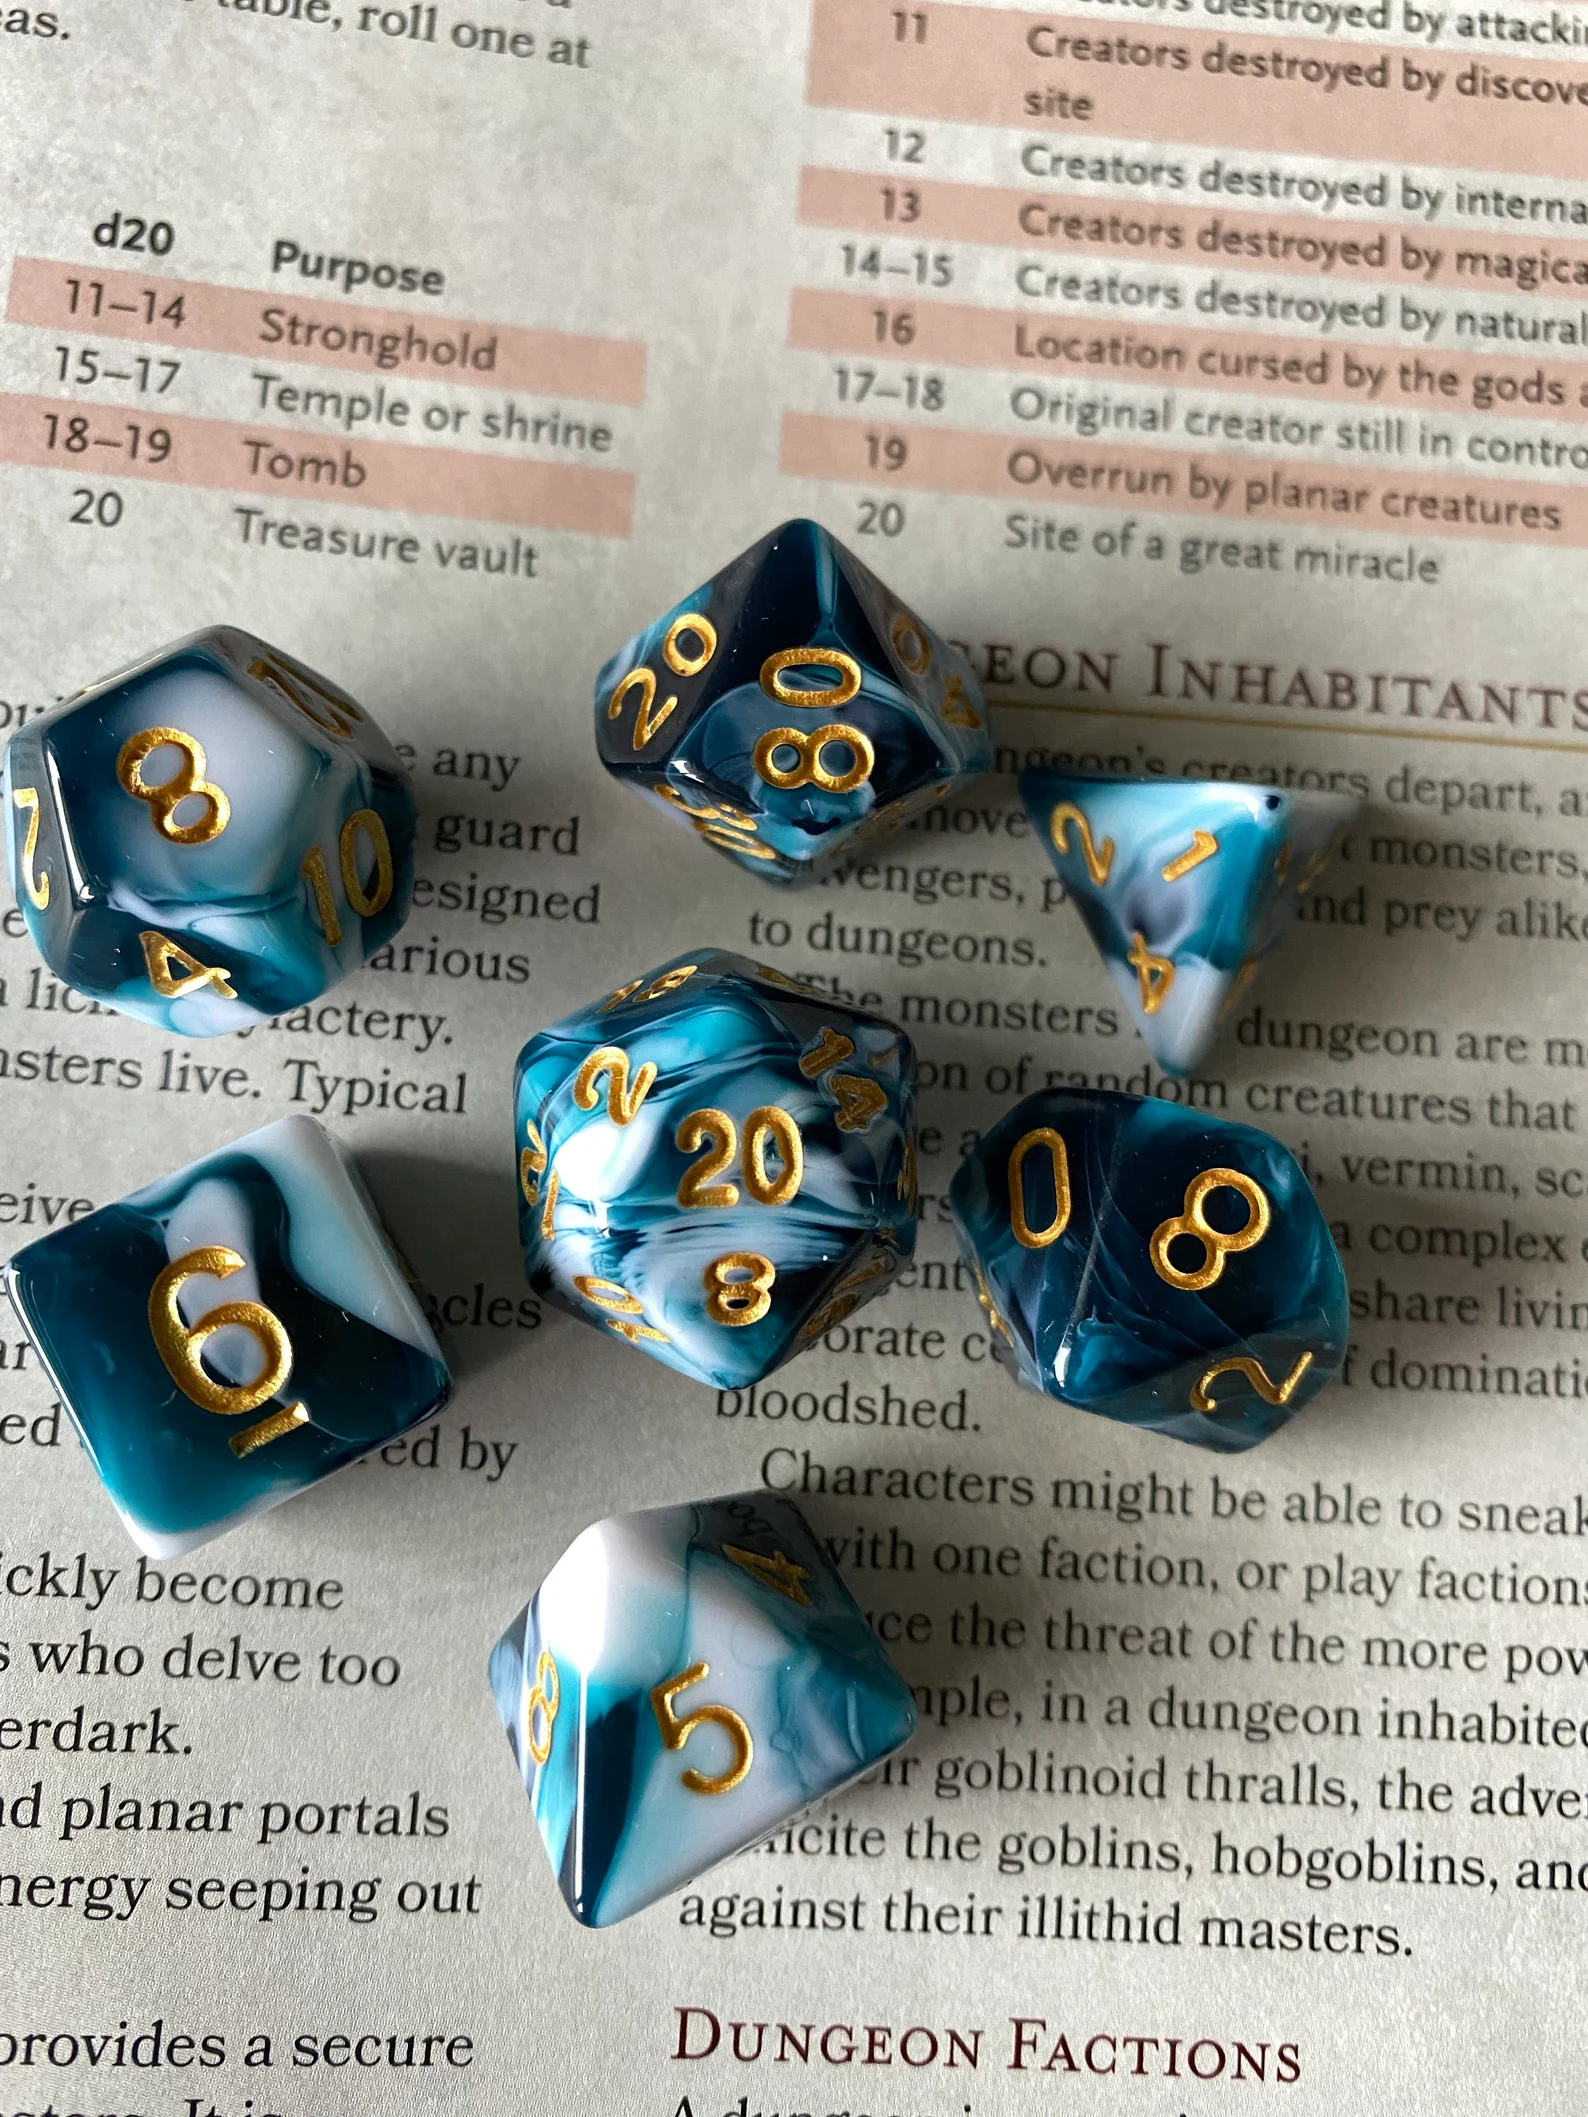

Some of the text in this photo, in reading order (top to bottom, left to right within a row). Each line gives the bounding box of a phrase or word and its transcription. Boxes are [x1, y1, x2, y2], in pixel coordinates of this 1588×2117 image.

[358, 3, 589, 68] roll one at
[893, 10, 927, 43] 11
[1027, 25, 1190, 70] Creators
[1202, 41, 1389, 92] destroyed
[1403, 58, 1445, 101] by
[1404, 0, 1446, 41] by
[1025, 88, 1094, 121] site
[886, 129, 925, 163] 12
[1021, 144, 1185, 188] Creators
[1199, 161, 1387, 206] destroyed
[1402, 177, 1442, 217] by
[92, 211, 445, 295] d20 Purpose
[881, 187, 920, 222] 13
[1019, 203, 1184, 249] Creators
[1197, 219, 1387, 271] destroyed
[1401, 236, 1443, 280] by
[66, 278, 498, 370] 11–14 Stronghold
[843, 245, 1588, 344] 14–15 Creators destroyed by natural
[874, 309, 1565, 410] 16 Location cursed by the gods
[56, 345, 612, 451] 15–17 Temple or shrine
[837, 368, 944, 410] 17–18
[1011, 388, 1170, 436] Original
[1186, 412, 1323, 443] creator
[1338, 420, 1403, 450] still
[1418, 425, 1455, 459] in
[44, 413, 366, 488] 18–19 Tomb
[867, 433, 1561, 530] 19 Overrun by planar creatures
[69, 488, 537, 577] 20 Treasure vault
[857, 501, 1439, 583] 20 Site of a great miracle
[117, 727, 230, 844] 8
[433, 748, 521, 792] any
[1387, 766, 1542, 815] depart,
[434, 813, 580, 856] guard
[1050, 802, 1114, 885] 2
[1161, 829, 1217, 882] 1
[1370, 836, 1588, 881] monsters,
[303, 808, 394, 946] 10
[749, 911, 1046, 967] to dungeons.
[1384, 900, 1483, 942] prey
[140, 930, 238, 1000] 4
[1127, 930, 1175, 1015] 4
[900, 995, 1119, 1037] monsters
[1235, 1004, 1439, 1061] dungeon
[1456, 1033, 1528, 1064] are
[158, 1049, 466, 1116] live. Typical
[573, 1046, 657, 1127] 2
[798, 1025, 888, 1132] 14
[984, 1055, 1033, 1094] of
[1046, 1060, 1230, 1110] random
[1246, 1085, 1472, 1125] creatures
[1488, 1088, 1575, 1131] that
[675, 1105, 803, 1208] 20
[1007, 1127, 1071, 1249] 0
[1341, 1151, 1519, 1197] vermin,
[1150, 1168, 1270, 1290] 8
[1330, 1219, 1567, 1268] a complex
[703, 1251, 776, 1327] 8
[1350, 1278, 1480, 1325] share
[717, 1388, 982, 1432] bloodshed.
[1191, 1351, 1314, 1411] 2
[460, 1425, 518, 1483] by
[760, 1447, 1035, 1507] Characters
[1051, 1470, 1193, 1524] might
[1211, 1475, 1267, 1521] be
[1283, 1482, 1381, 1526] able
[1400, 1494, 1443, 1529] to
[135, 1556, 343, 1611] become
[722, 1543, 812, 1608] 4
[933, 1543, 1021, 1577] one
[1040, 1535, 1219, 1594] faction,
[1237, 1560, 1288, 1592] or
[1304, 1552, 1402, 1608] play
[28, 1628, 144, 1677] who
[162, 1632, 300, 1683] delve
[320, 1646, 401, 1688] too
[950, 1601, 1488, 1672] the threat of the more
[528, 1650, 560, 1767] 8
[650, 1663, 755, 1795] 5
[1042, 1680, 1361, 1744] in a dungeon
[59, 1782, 244, 1841] planar
[257, 1790, 449, 1845] portals
[935, 1747, 1453, 1815] goblinoid thralls, the
[905, 1816, 1498, 1895] the goblins, hobgoblins,
[166, 1866, 482, 1924] seeping out
[679, 1885, 1412, 1957] against their illithid masters.
[244, 2034, 473, 2068] a secure
[670, 2007, 1301, 2084] DUNGEON FACTIONS
